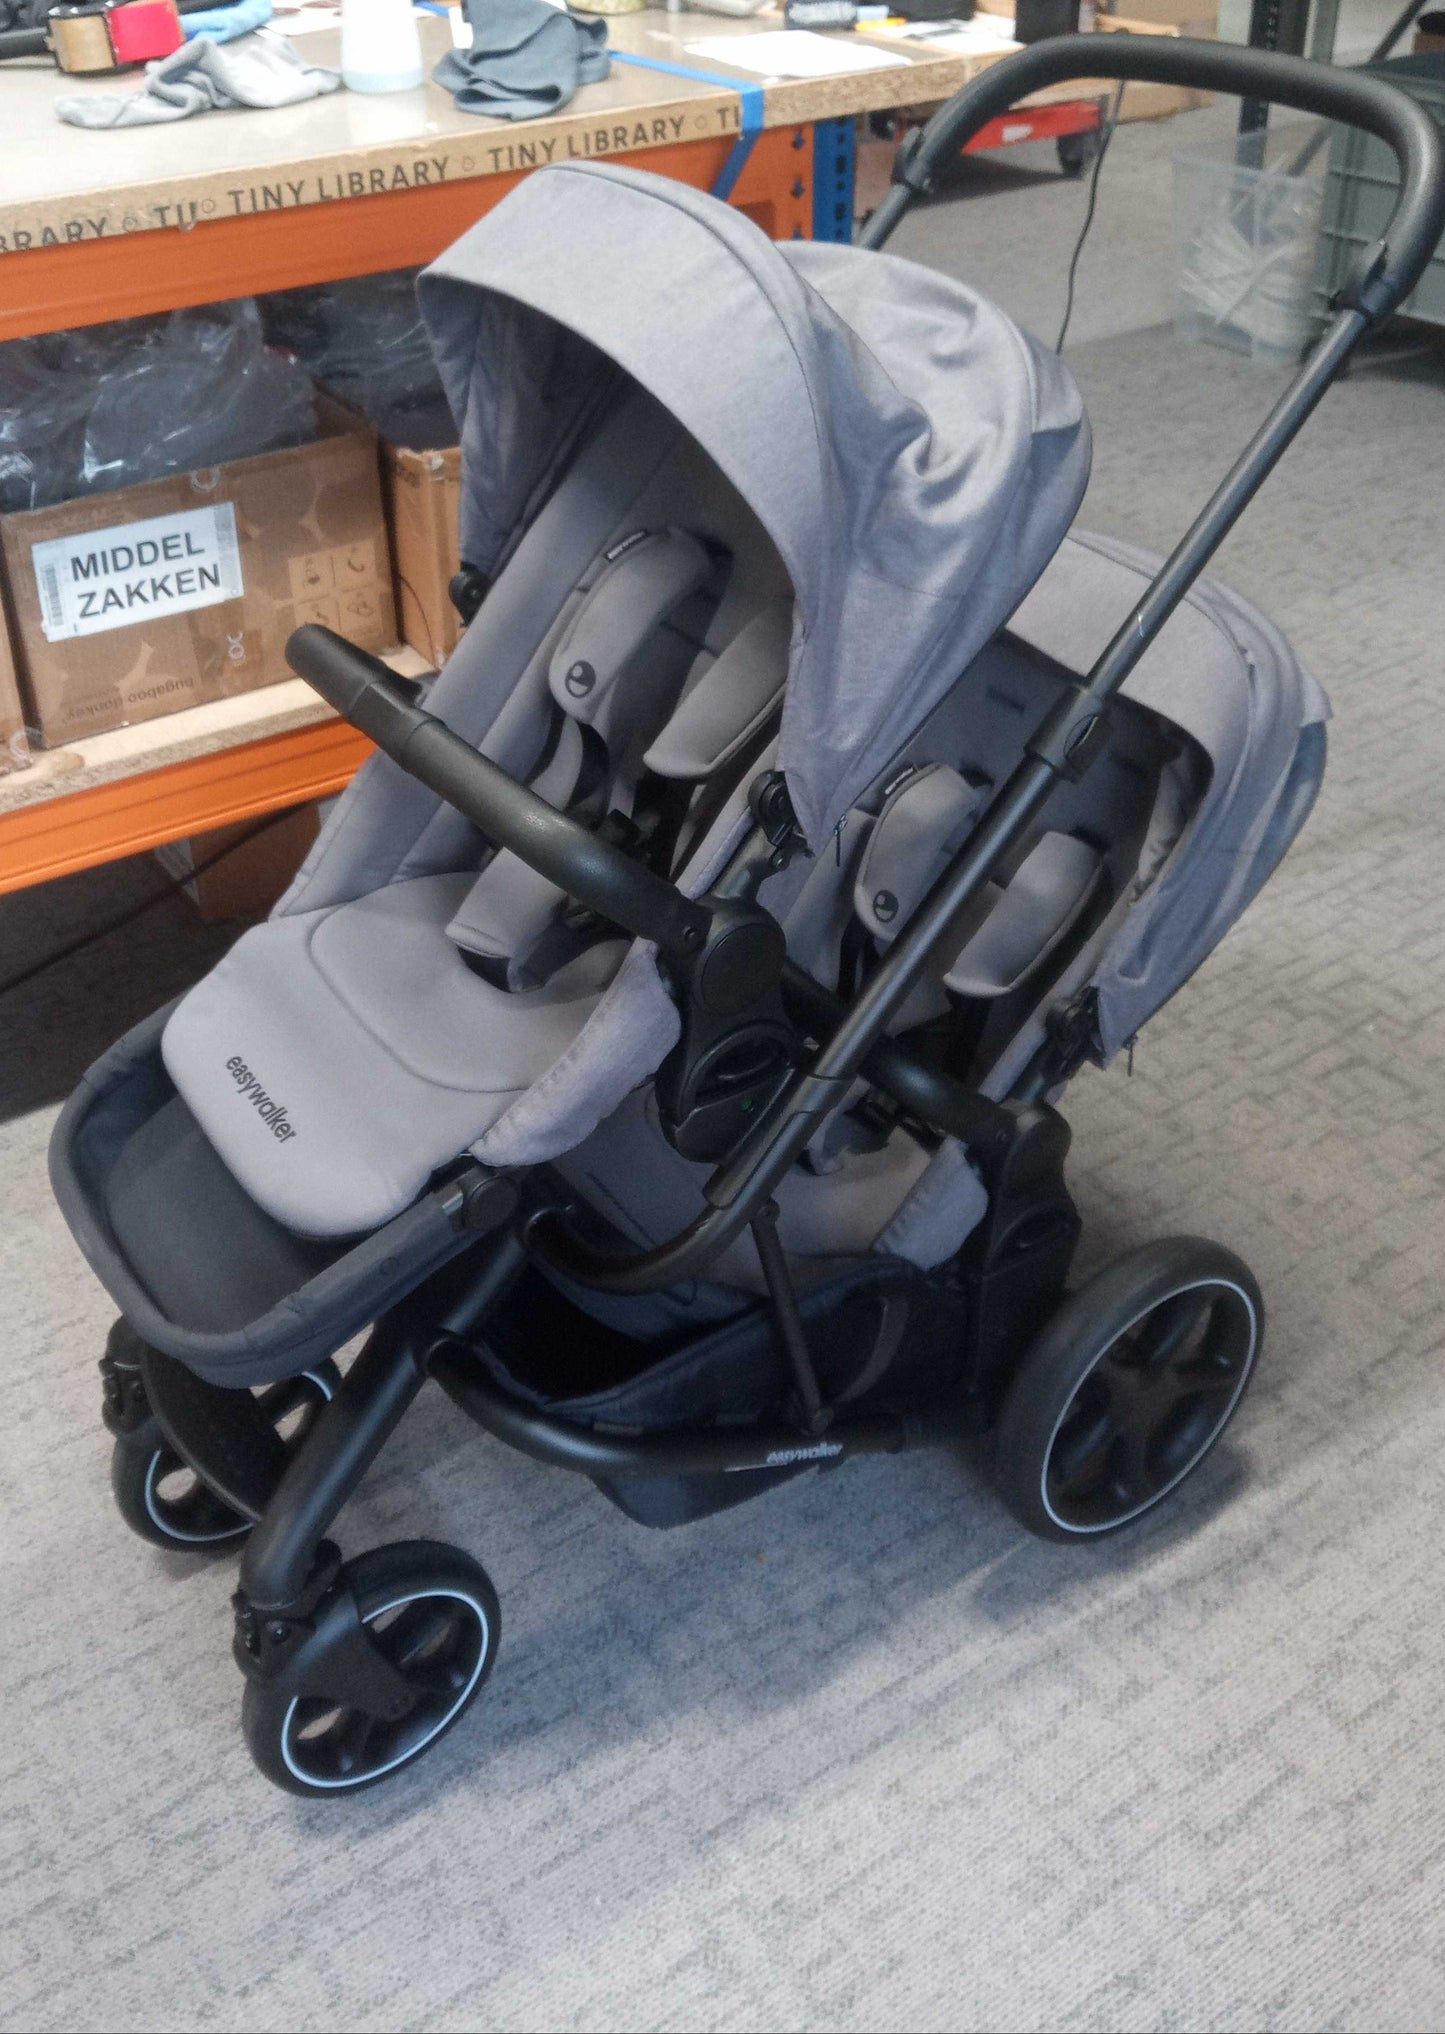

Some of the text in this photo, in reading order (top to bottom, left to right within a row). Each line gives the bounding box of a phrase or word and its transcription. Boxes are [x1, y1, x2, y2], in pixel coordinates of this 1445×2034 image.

[227, 179, 305, 214] TINY
[317, 156, 450, 200] LIBRARY
[487, 138, 557, 172] TINY
[566, 114, 686, 157] LIBRARY
[70, 532, 206, 582] MIDDEL
[77, 563, 221, 620] ZAKKEN
[226, 1056, 297, 1143] easywalker
